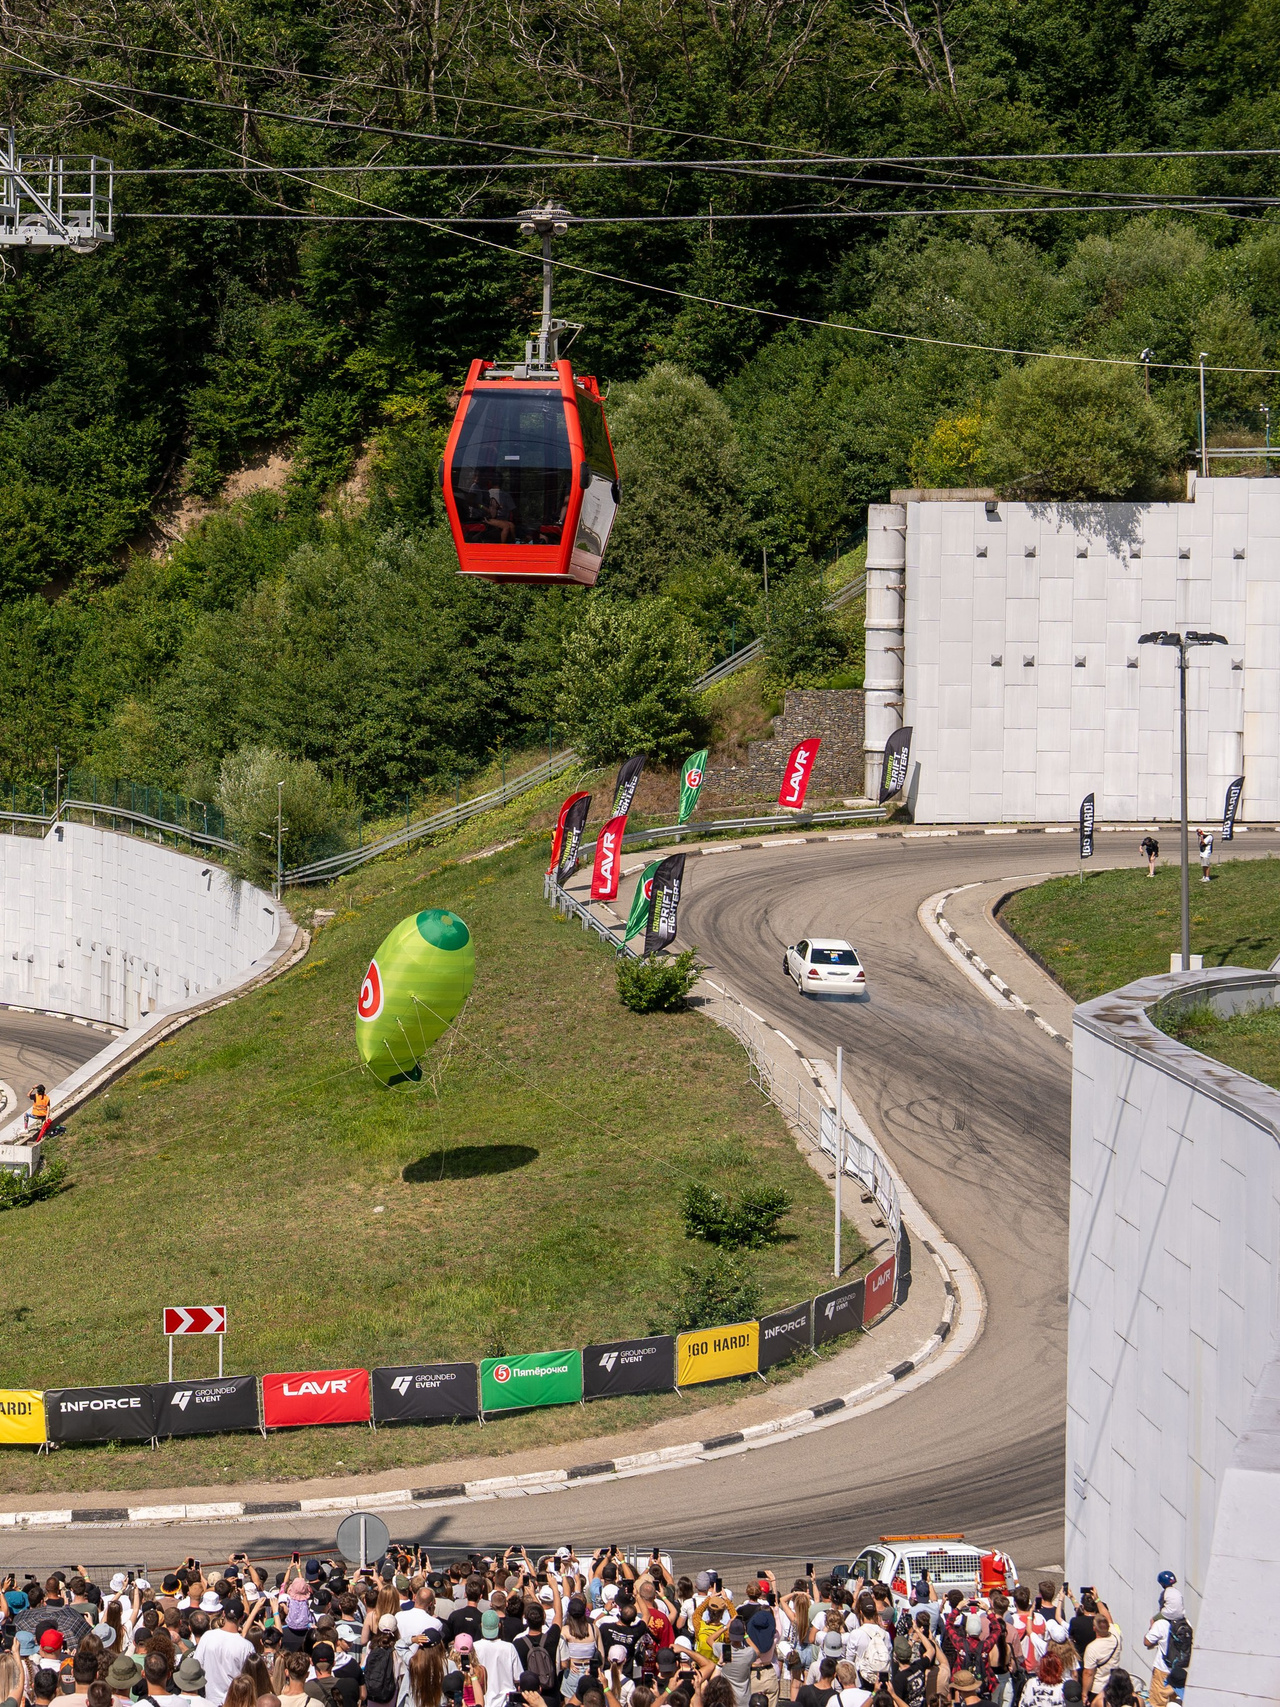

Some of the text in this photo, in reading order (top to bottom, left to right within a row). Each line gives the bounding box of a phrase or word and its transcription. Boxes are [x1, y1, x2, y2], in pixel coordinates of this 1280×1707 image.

[786, 750, 810, 802] LAVR
[889, 751, 901, 789] DRIFT
[896, 746, 909, 790] FIGHTERS
[1082, 802, 1094, 856] !GO HARD!
[598, 832, 616, 894] LAVR
[652, 890, 663, 933] GROUNDED
[659, 885, 673, 934] DRIFT
[667, 878, 680, 934] FIGHTERS
[872, 1268, 891, 1293] LAVR
[764, 1315, 807, 1340] INFORCE
[620, 1347, 657, 1358] GROUNDED
[687, 1333, 750, 1358] !GO HARD!
[513, 1365, 568, 1378] Пятёрочка
[620, 1355, 643, 1364] EVENT
[283, 1379, 348, 1397] LAVR
[415, 1373, 457, 1382] GROUNDED
[415, 1380, 441, 1389] EVENT
[195, 1386, 237, 1397] GROUNDED
[195, 1395, 221, 1404] EVENT
[60, 1397, 142, 1413] INFORCE
